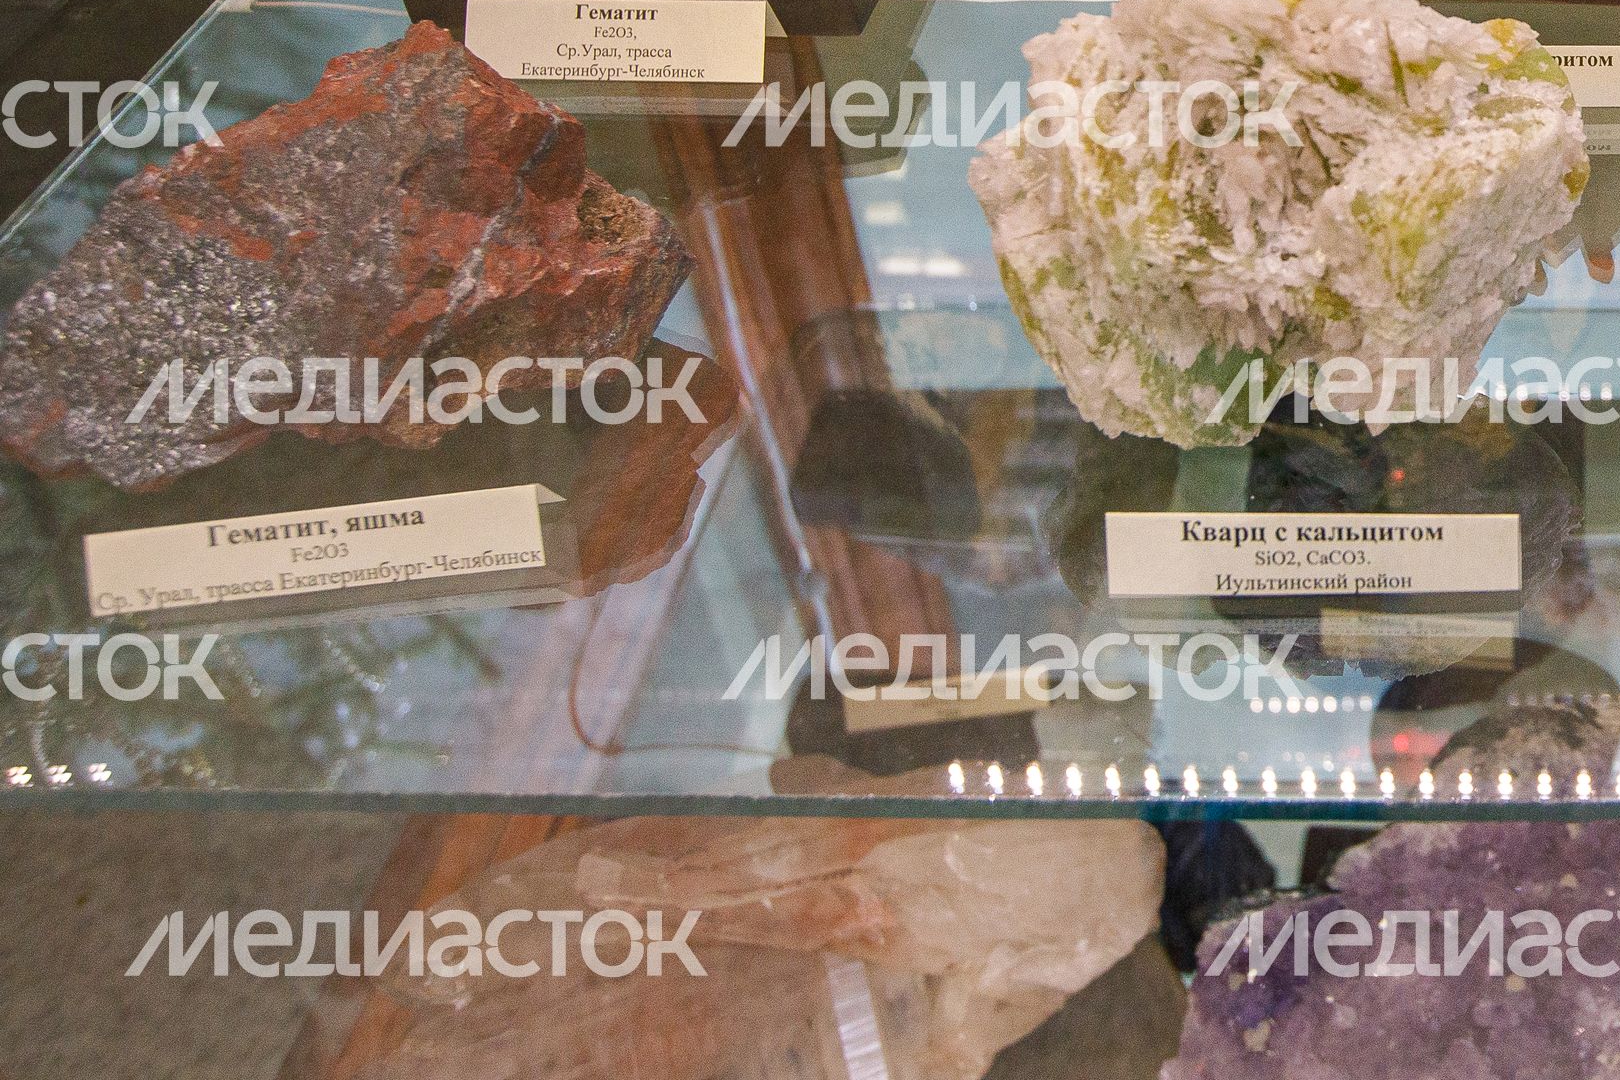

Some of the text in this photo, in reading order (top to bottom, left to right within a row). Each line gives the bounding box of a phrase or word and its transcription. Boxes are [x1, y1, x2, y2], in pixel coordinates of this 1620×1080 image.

[575, 4, 659, 21] Гематит
[594, 27, 637, 40] Fe2O3,
[626, 47, 672, 61] трасса
[521, 63, 705, 81] Екатеринбург-Челябинск
[206, 508, 425, 547] Гематит, яшма
[1181, 521, 1444, 548] Кварц с кальцитом
[290, 544, 350, 563] Fe2O3
[1255, 550, 1371, 567] SiO2, CaCO3.
[97, 591, 135, 613] Ср.
[205, 577, 274, 602] трасса
[279, 548, 543, 589] Екатеринбург-Челябинск
[1215, 573, 1412, 596] Иультинский район
